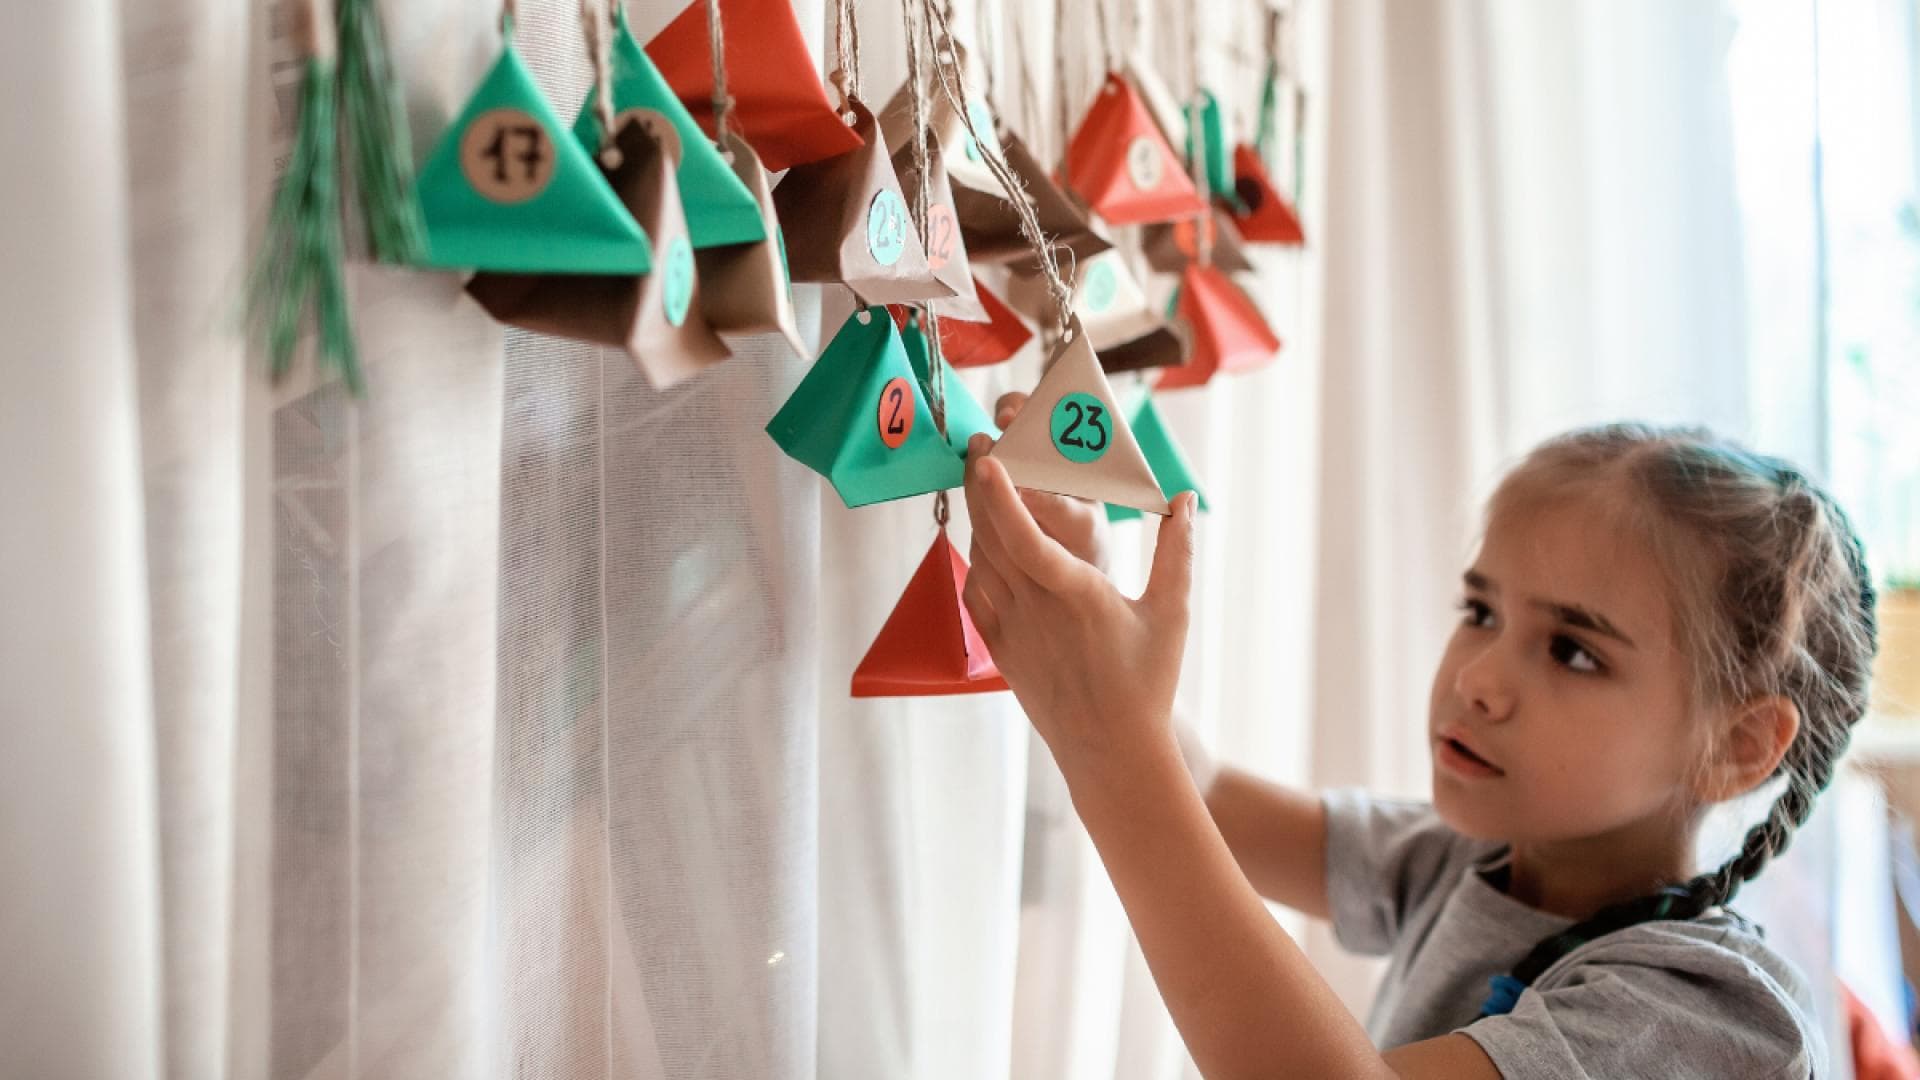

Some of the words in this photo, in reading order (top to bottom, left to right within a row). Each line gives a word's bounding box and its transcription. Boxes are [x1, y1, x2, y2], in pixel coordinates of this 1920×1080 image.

[480, 126, 542, 183] 17
[887, 387, 904, 434] 2
[1059, 400, 1106, 451] 23
